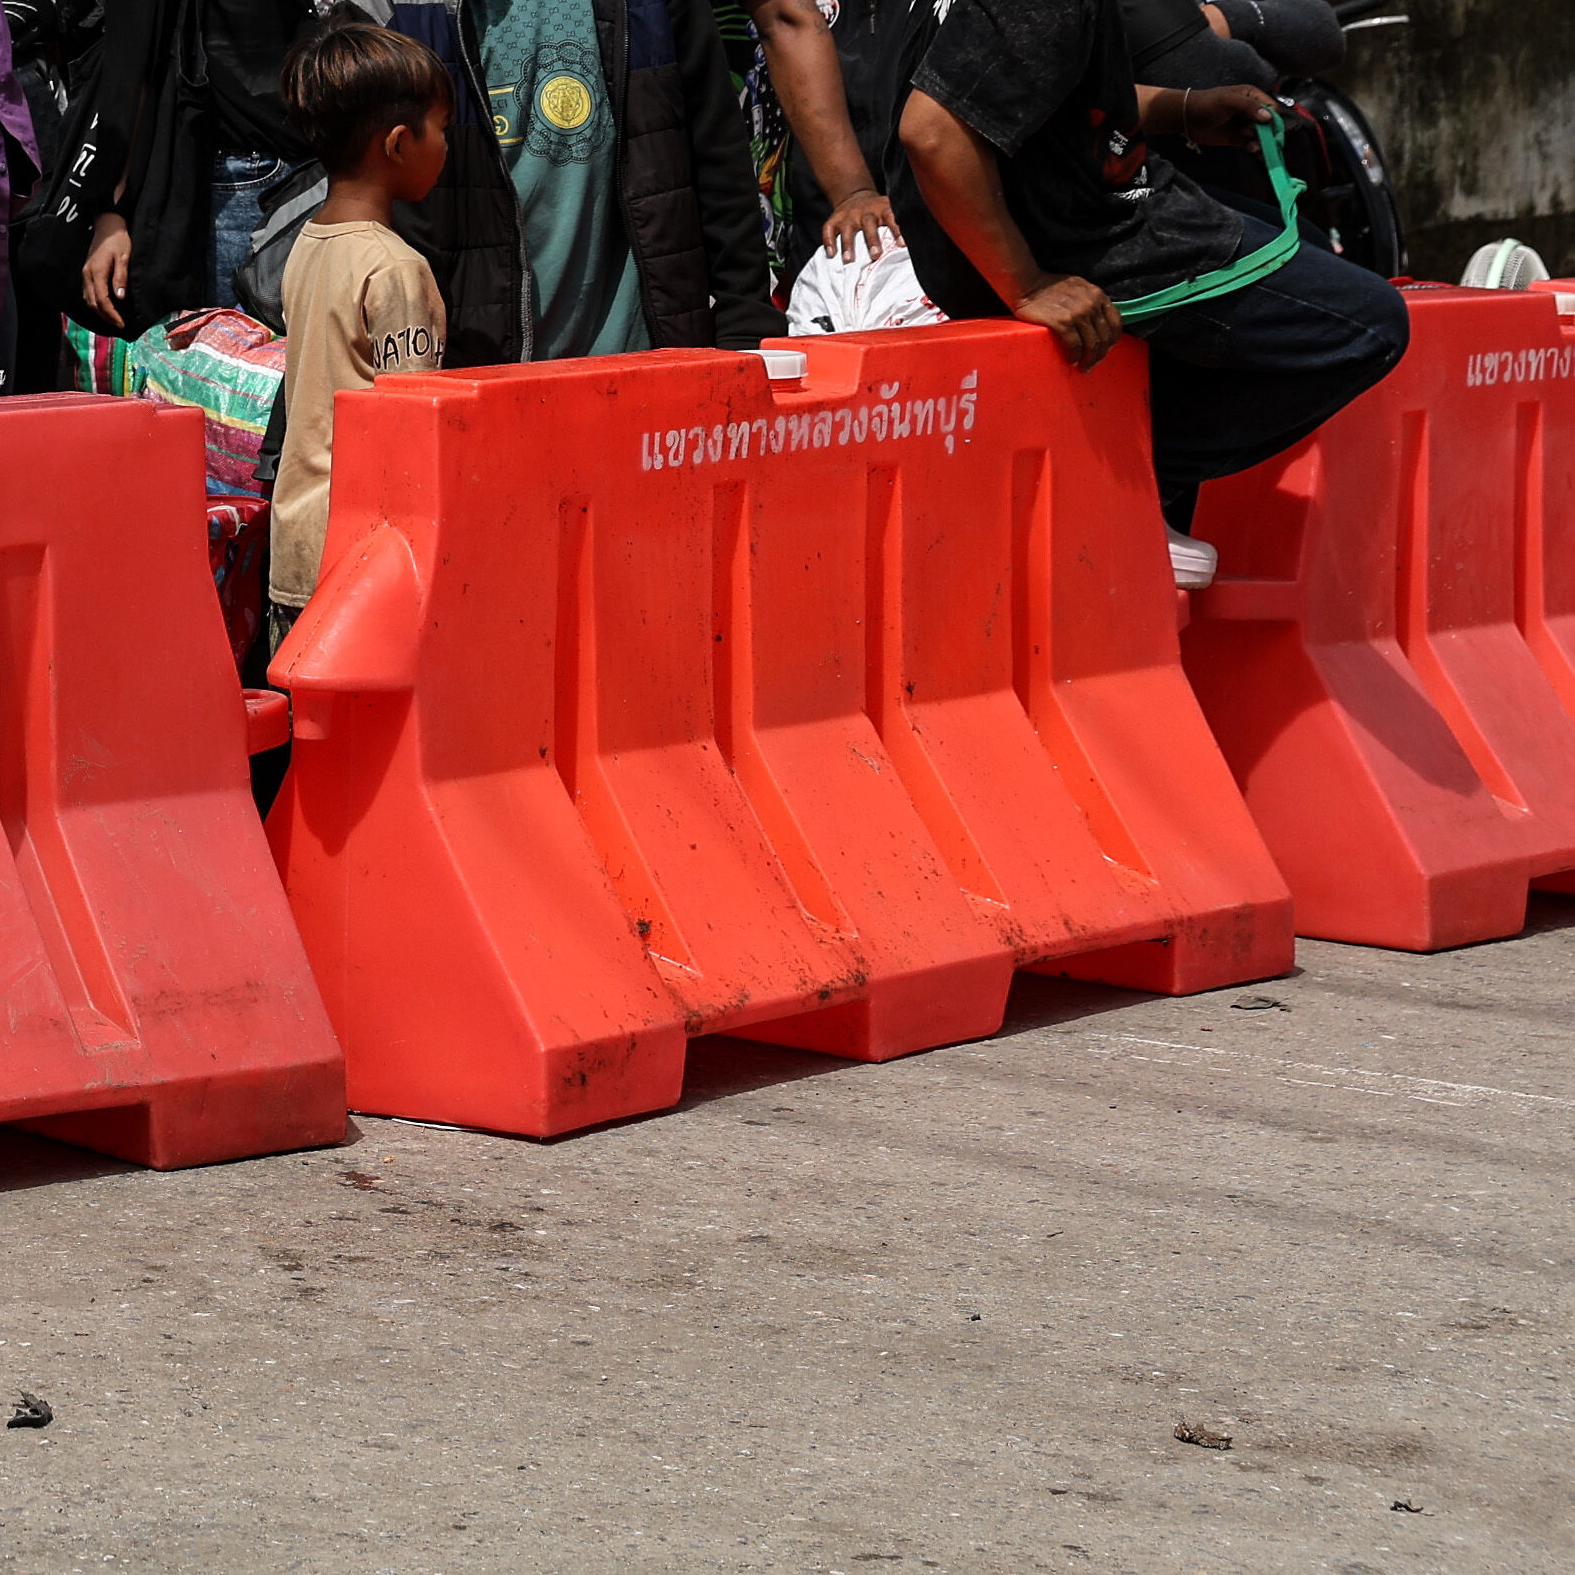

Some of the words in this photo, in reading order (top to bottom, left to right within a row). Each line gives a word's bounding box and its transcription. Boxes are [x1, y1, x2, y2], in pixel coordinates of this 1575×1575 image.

[639, 369, 980, 472] แขวงทางหลวงจันทบุรี
